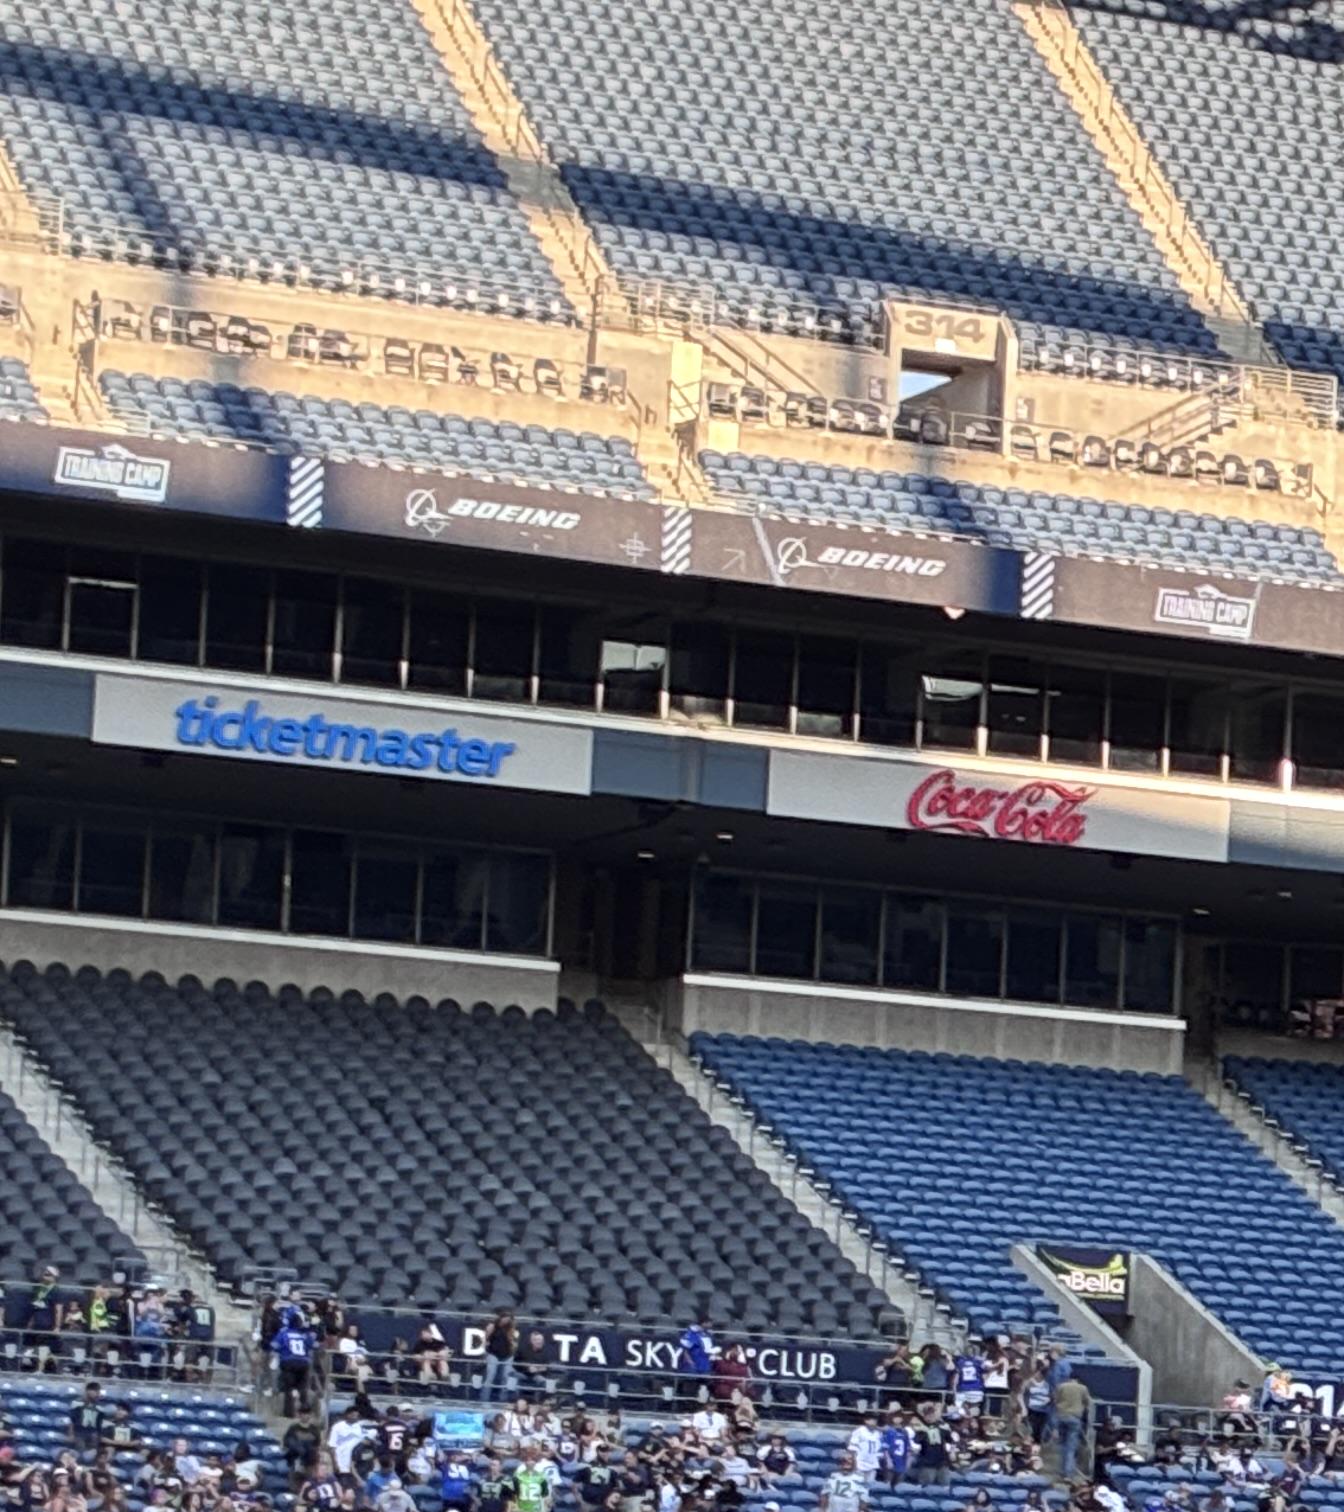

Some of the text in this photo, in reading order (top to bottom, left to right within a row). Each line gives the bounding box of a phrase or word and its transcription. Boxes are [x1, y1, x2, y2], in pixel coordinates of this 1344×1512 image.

[904, 309, 986, 343] 314
[64, 454, 163, 487] TRAINING CAMP
[447, 497, 580, 531] BOEING
[816, 546, 947, 578] BOEING
[1162, 596, 1249, 625] TRAINING CAMP
[174, 696, 516, 780] ticketmaster
[462, 1327, 836, 1380] DTA SKY CLUB
[519, 1483, 542, 1501] 12
[834, 1479, 853, 1497] 12
